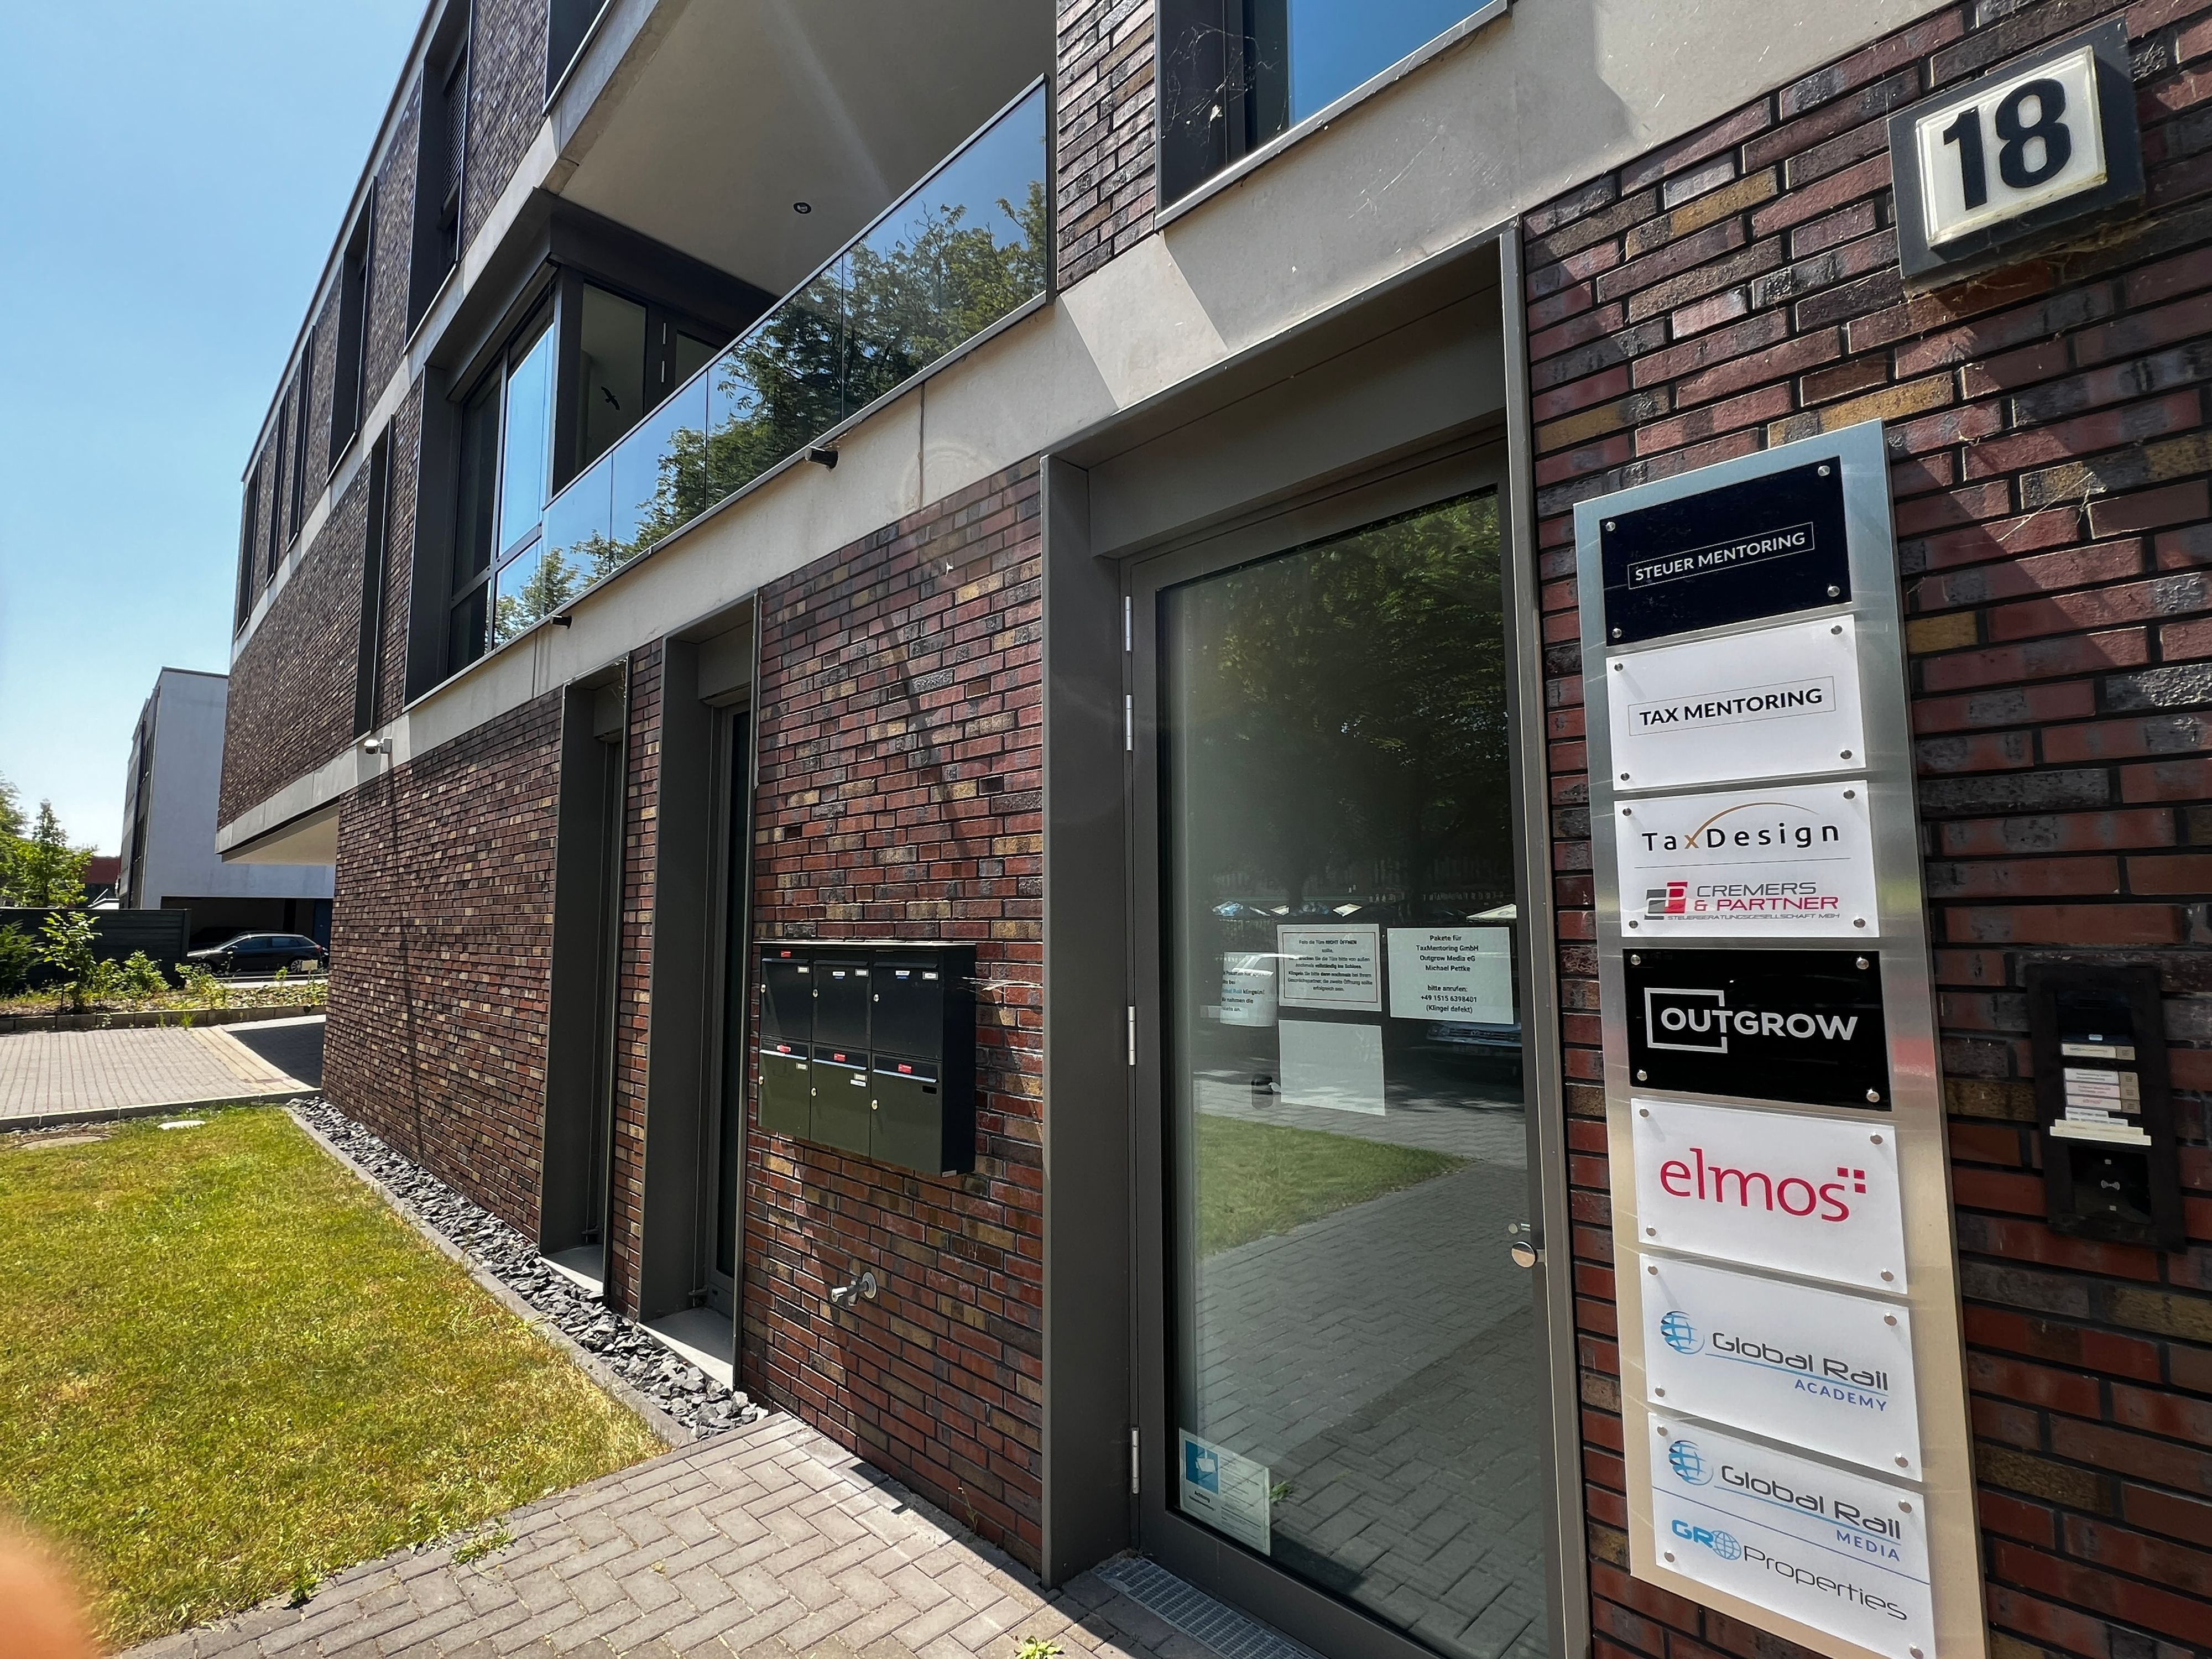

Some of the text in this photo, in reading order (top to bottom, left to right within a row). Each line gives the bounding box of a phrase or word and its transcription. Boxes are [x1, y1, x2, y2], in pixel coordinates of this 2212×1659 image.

[1943, 78, 2072, 211] 18
[1635, 531, 1806, 582] STEUER MENTORING
[1639, 688, 1823, 726] TAX MENTORING
[1641, 822, 1839, 852] TaxDesign
[1694, 896, 1839, 912] & PARTNER
[1697, 881, 1817, 898] CREMERS
[1416, 945, 1458, 953] TaxMentoring
[1426, 1004, 1473, 1014] (Klingel defekt)
[1660, 1007, 1859, 1041] OUTGROW
[1660, 1147, 1850, 1222] elmos
[1712, 1332, 1889, 1391] Global Rail
[1794, 1379, 1888, 1412] ACADEMY
[1721, 1465, 1901, 1540] Global Rail
[1835, 1530, 1901, 1562] MEDIA
[1743, 1545, 1908, 1621] Properties
